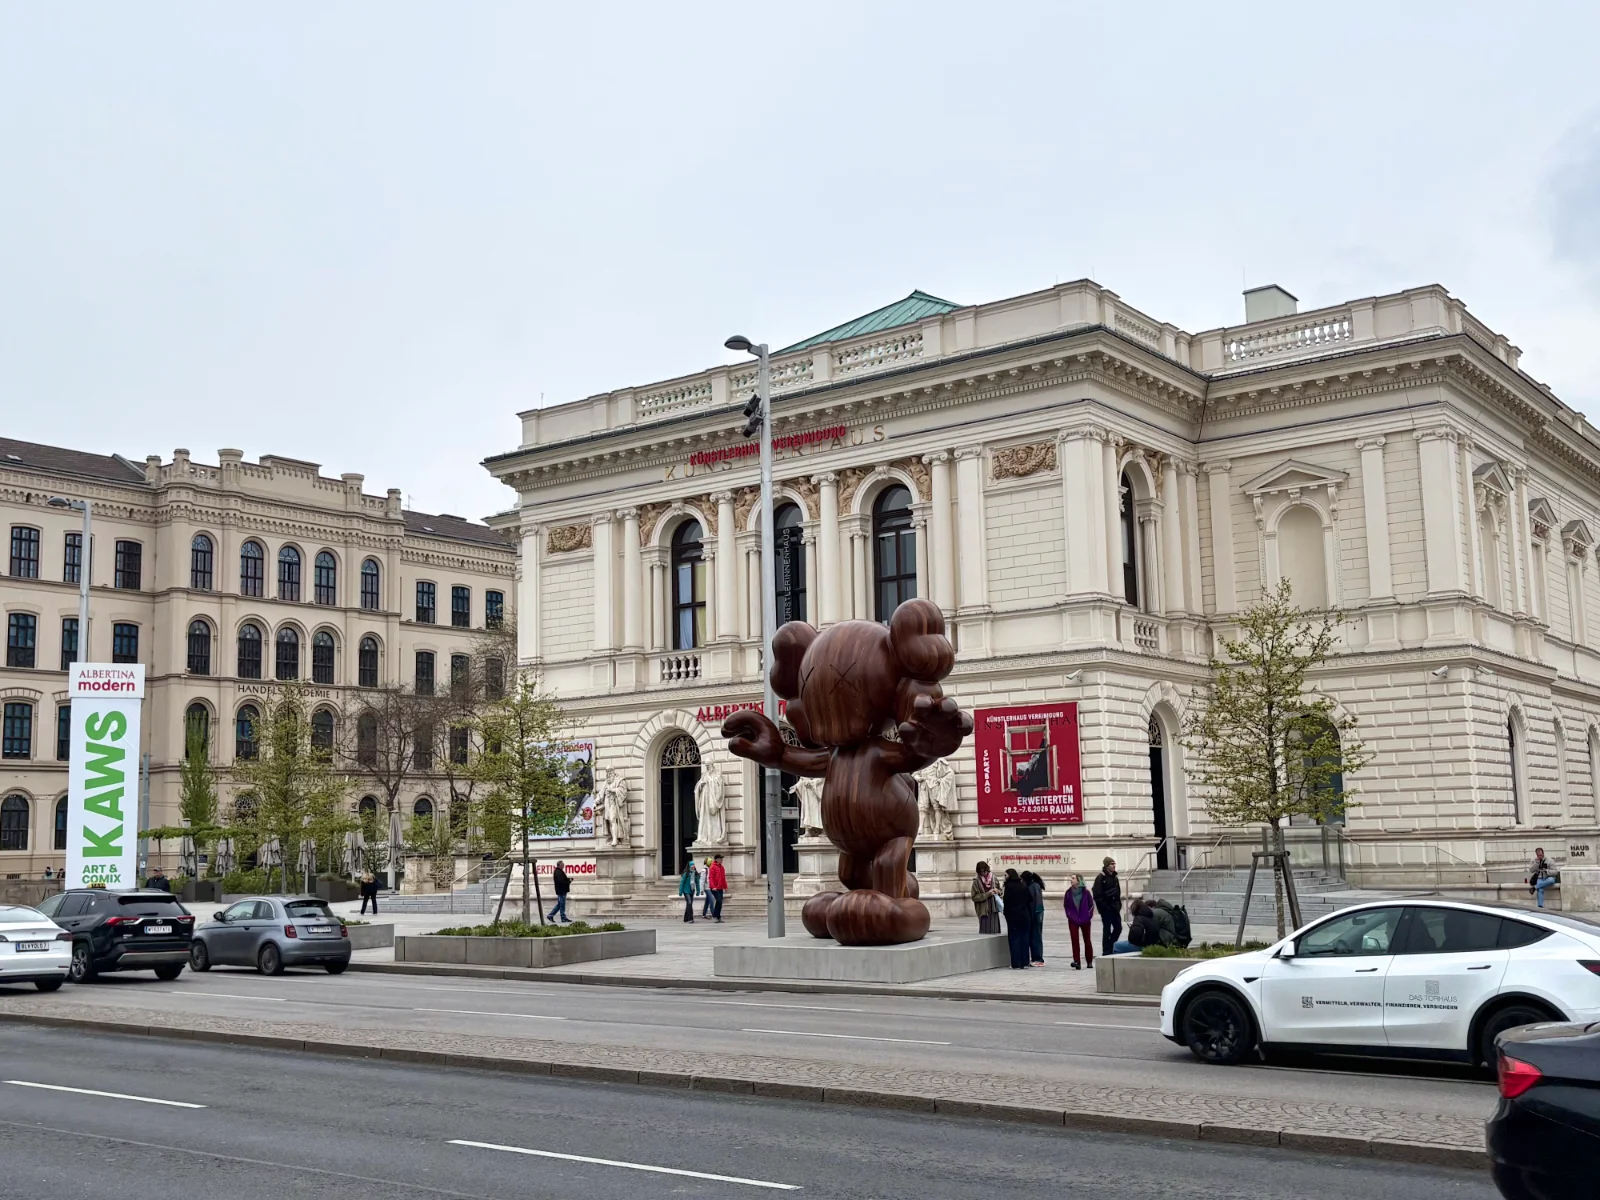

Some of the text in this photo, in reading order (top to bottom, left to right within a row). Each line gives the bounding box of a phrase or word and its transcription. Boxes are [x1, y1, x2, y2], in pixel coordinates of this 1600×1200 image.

[690, 425, 845, 466] KÜNSTLERHAU VEREINIGUNG
[79, 669, 135, 679] ALBERTINA
[78, 679, 135, 691] modern
[696, 702, 764, 722] ALBERTIN
[987, 712, 1063, 723] KÜNSTLERHAUS VEREINIGUNG
[983, 749, 991, 794] STRABAG
[82, 710, 127, 857] KAWS
[1063, 785, 1073, 794] IM
[1017, 795, 1074, 806] ERWEITERTEN
[1050, 805, 1074, 815] RAUM
[82, 864, 118, 874] ART &
[564, 861, 597, 874] moder
[82, 874, 121, 884] COMIX
